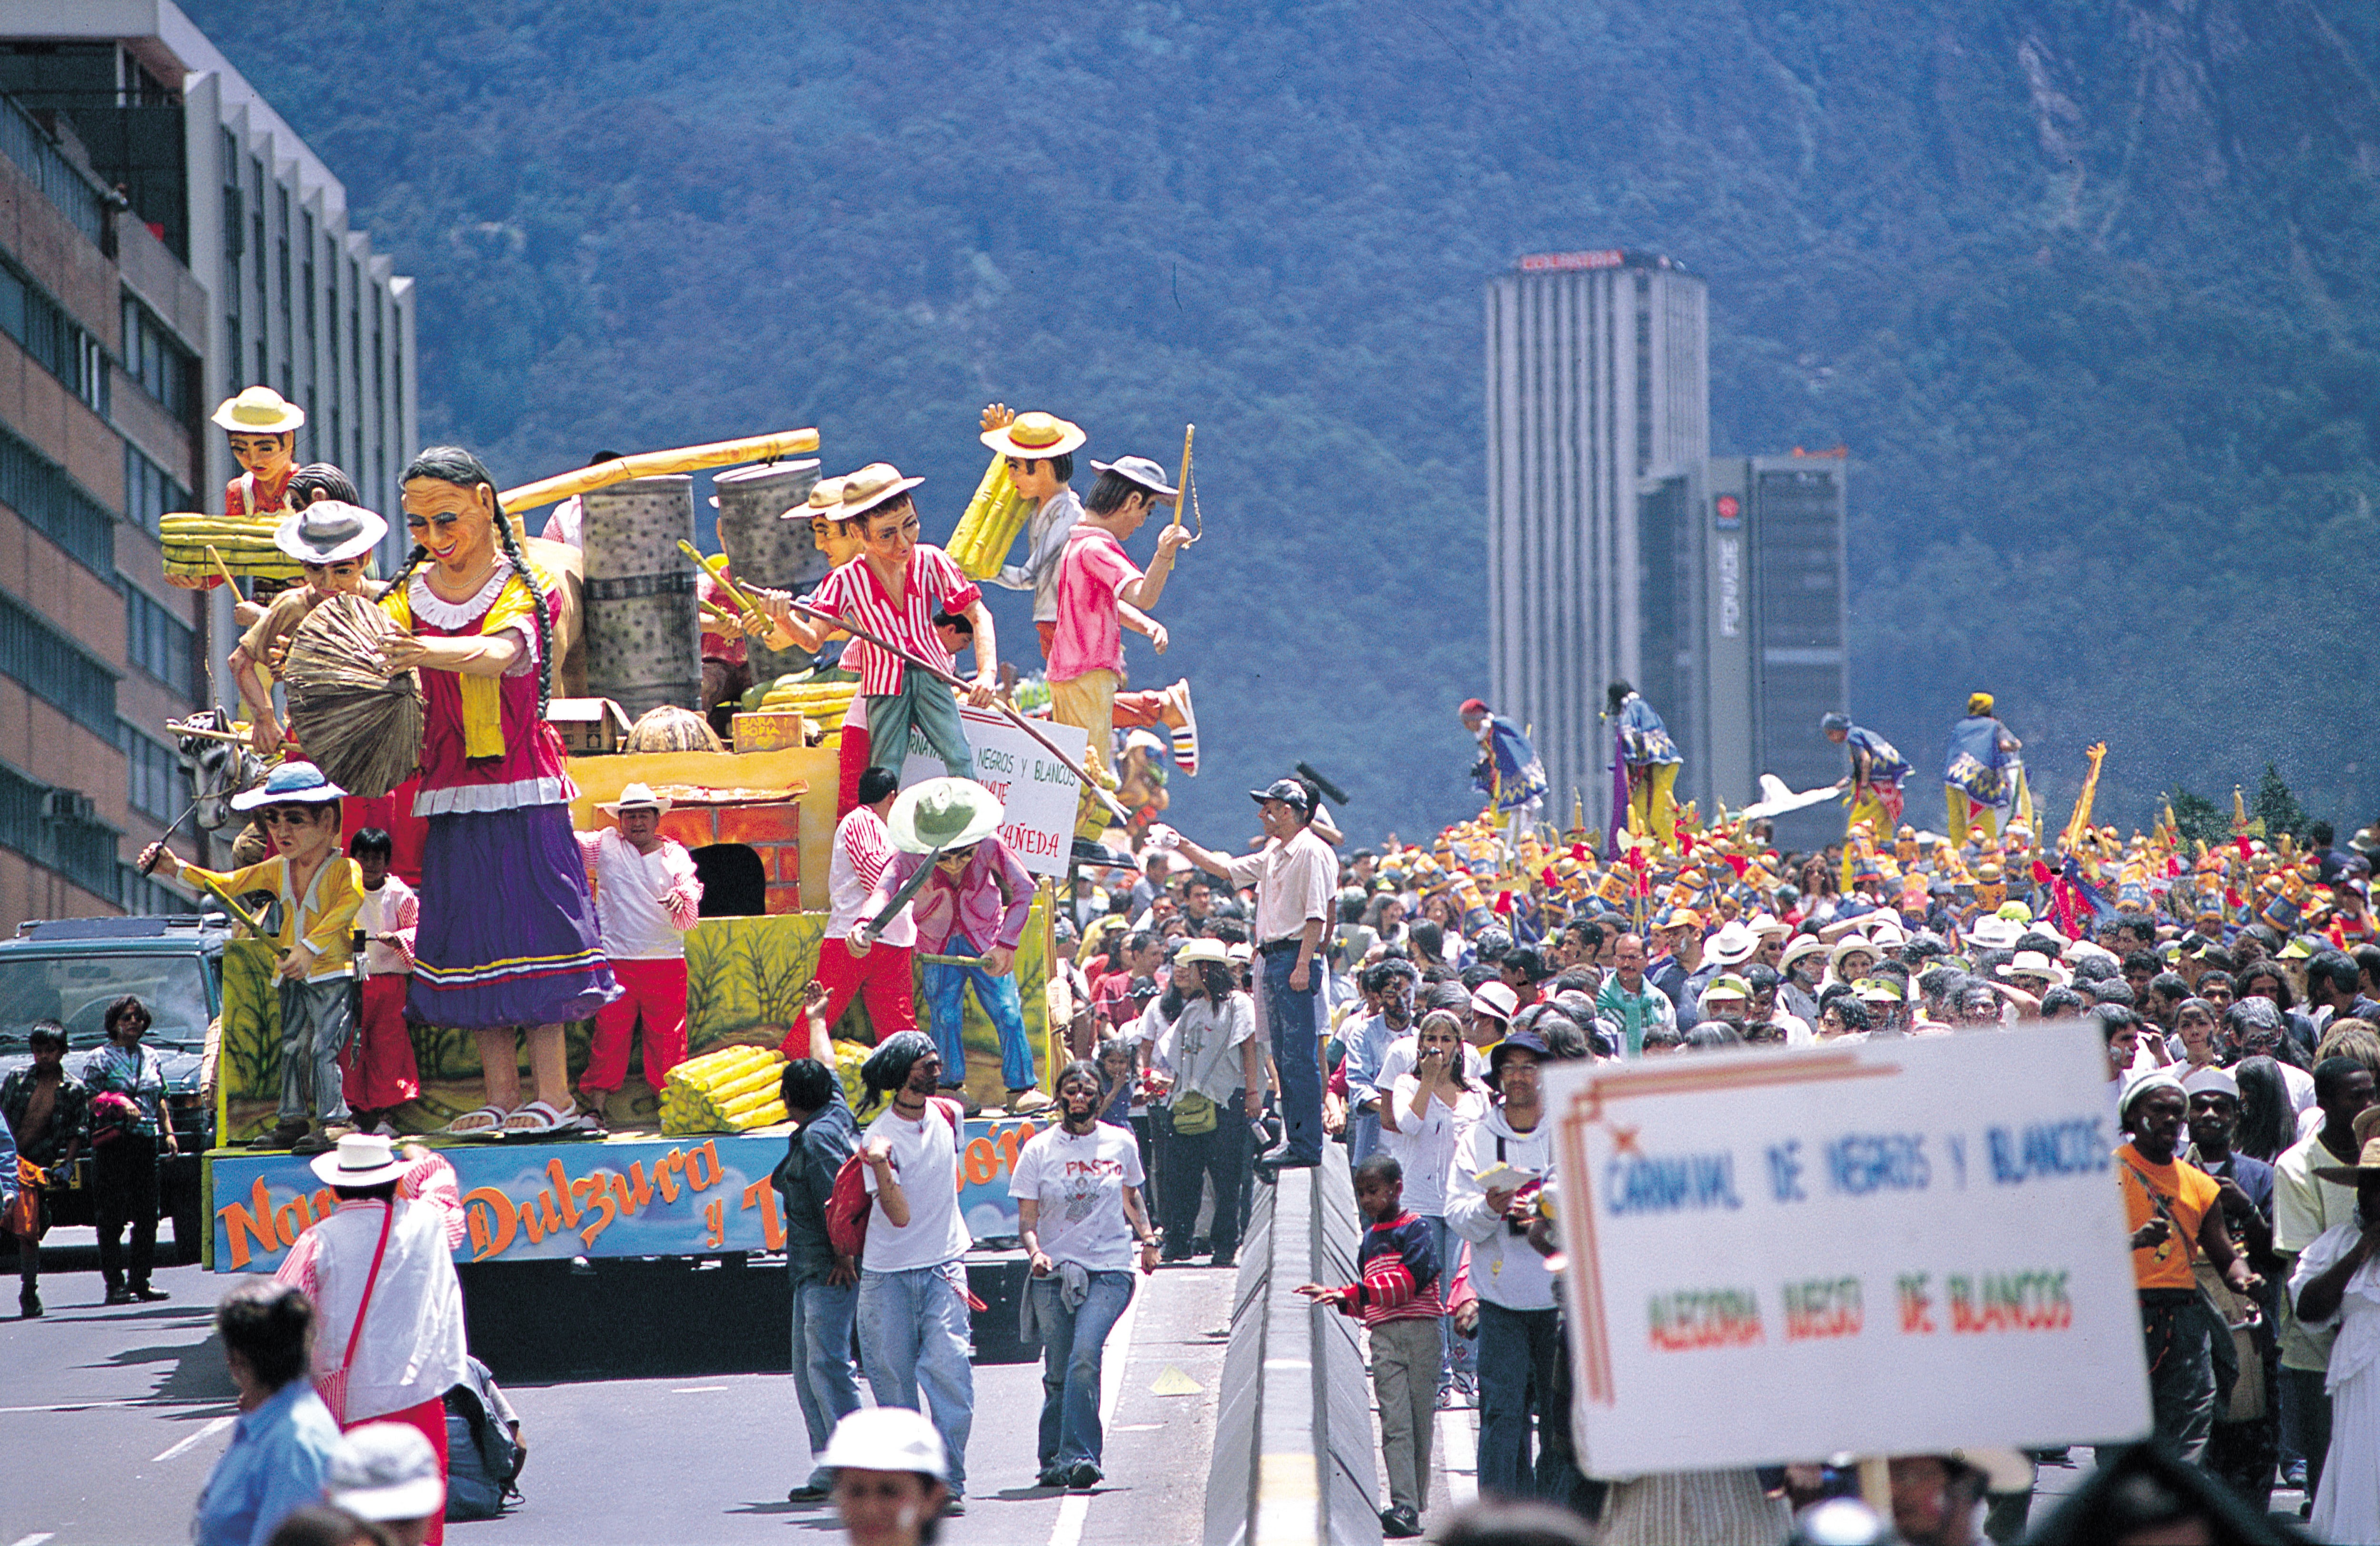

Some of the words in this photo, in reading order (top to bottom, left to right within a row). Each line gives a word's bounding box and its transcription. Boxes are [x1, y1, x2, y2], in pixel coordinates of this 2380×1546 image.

[977, 748, 1014, 774] NEGROS
[1021, 758, 1028, 778] Y
[1034, 760, 1075, 787] BLANCOS
[462, 1139, 725, 1263] Dulzura
[704, 1197, 724, 1249] y
[1602, 1148, 1743, 1216] CARNAVAL
[1765, 1137, 1807, 1203] DE
[1824, 1133, 1932, 1195] NEGROS
[1948, 1133, 1968, 1190] Y
[1986, 1116, 2109, 1184] BLANCOS
[1895, 1271, 1935, 1334] DE
[1946, 1270, 2073, 1333] BLANCOS
